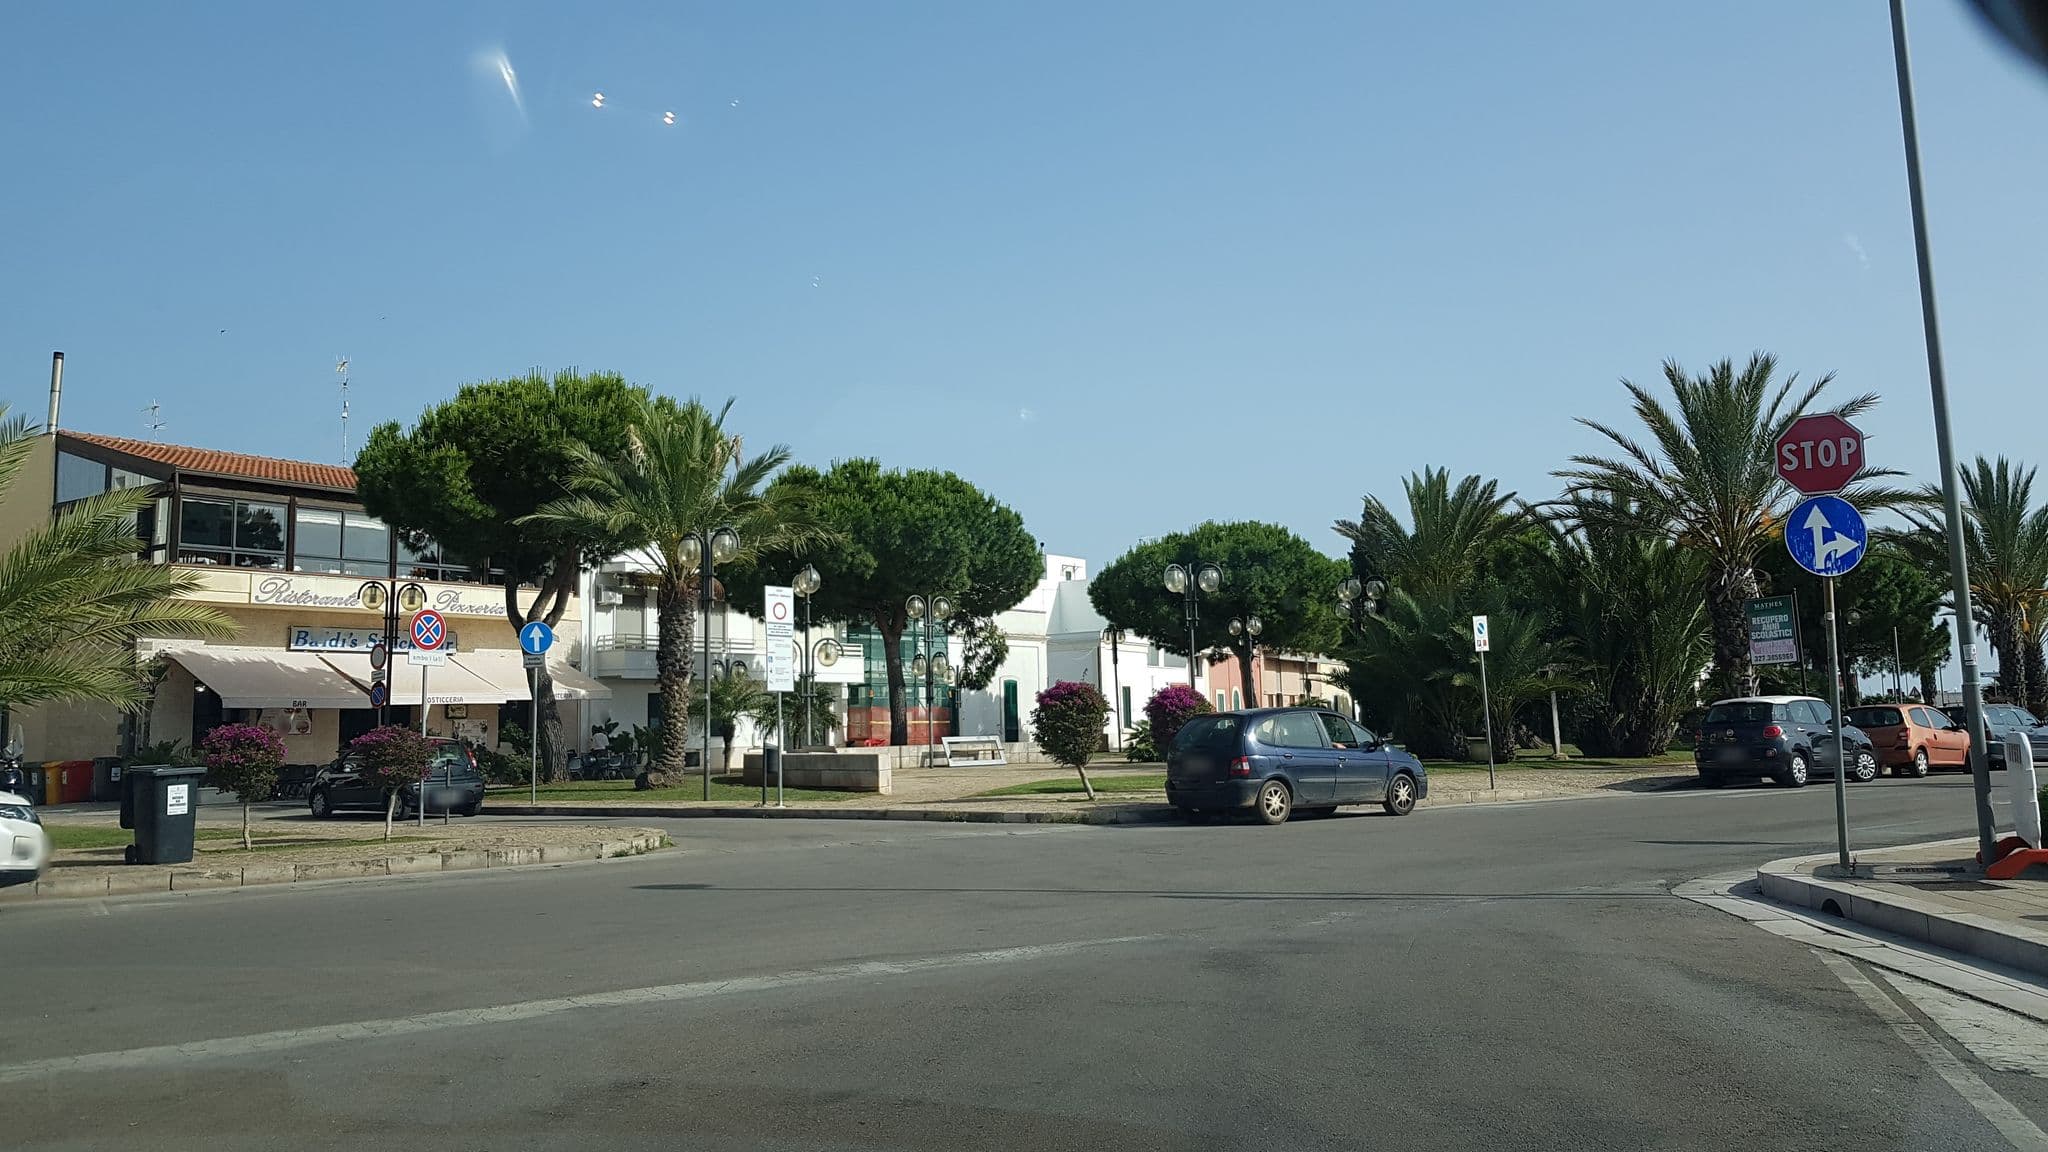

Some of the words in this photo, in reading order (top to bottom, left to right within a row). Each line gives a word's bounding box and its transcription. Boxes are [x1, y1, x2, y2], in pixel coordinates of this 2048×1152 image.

[1781, 437, 1858, 471] STOP
[255, 577, 360, 607] Ristorante
[432, 590, 506, 614] Pizzeria
[1751, 614, 1789, 625] RECUPERO
[1751, 629, 1793, 640] SCOLASTICI
